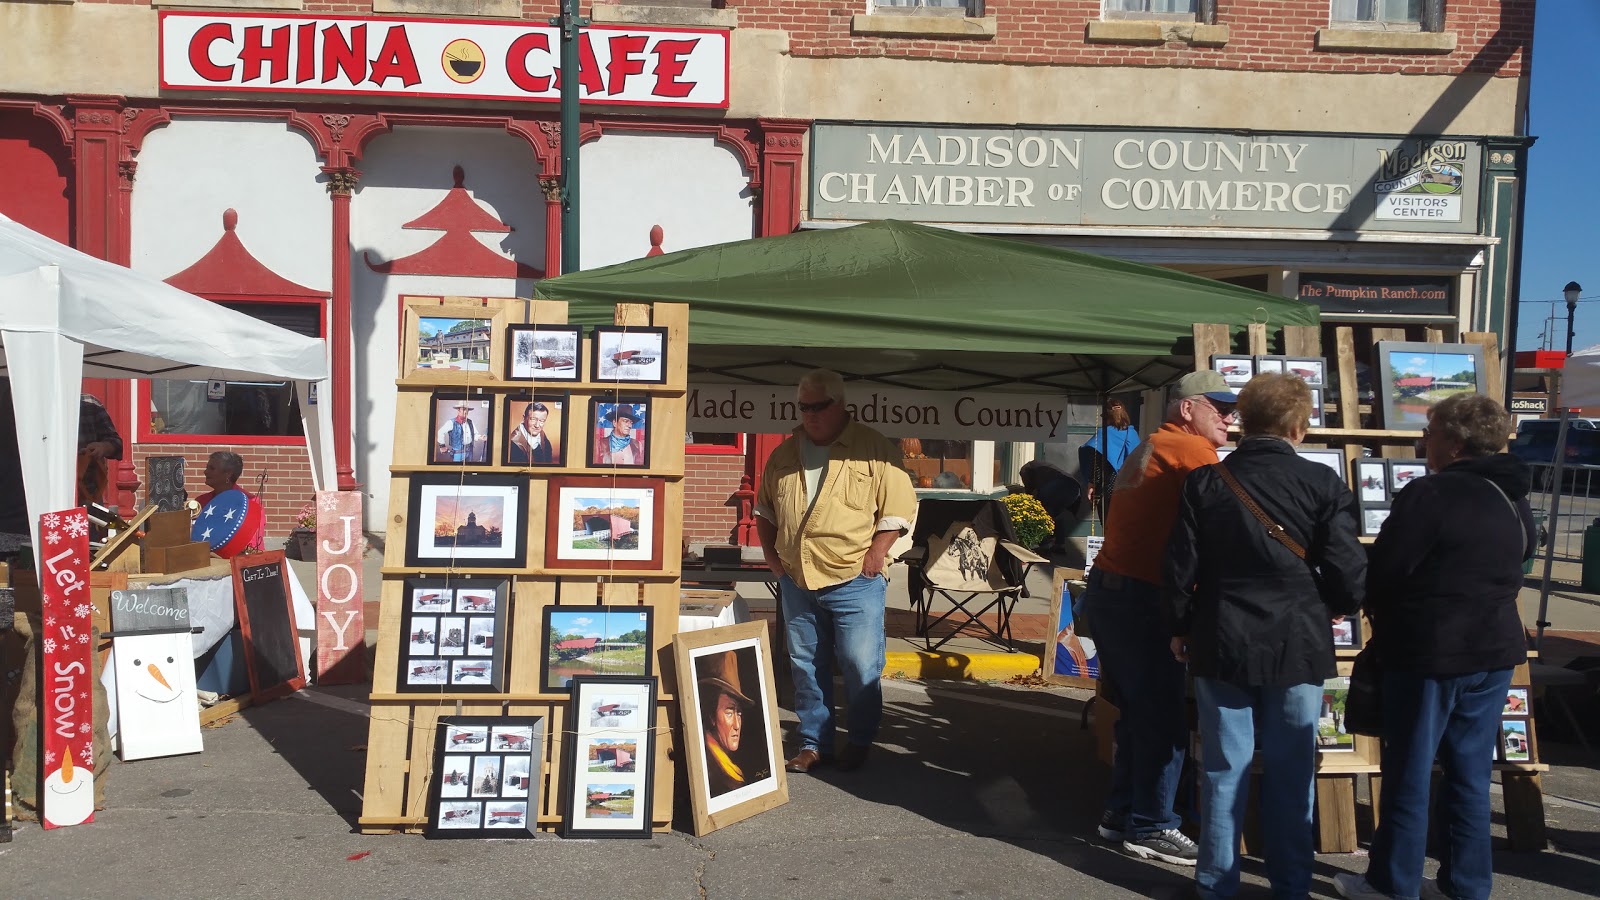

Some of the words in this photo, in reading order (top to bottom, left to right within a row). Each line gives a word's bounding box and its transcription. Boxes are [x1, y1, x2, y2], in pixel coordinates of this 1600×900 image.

[187, 22, 422, 87] CHINA
[504, 32, 701, 99] CAFE
[868, 133, 1082, 169] MADISON
[1112, 138, 1309, 174] COUNTY
[1377, 140, 1466, 182] Madison
[818, 172, 1035, 209] CHAMBER
[1047, 183, 1082, 201] OF
[1101, 179, 1352, 214] COMMERCE
[1376, 171, 1420, 191] COUNTY
[1389, 197, 1448, 207] VISITORS
[1393, 208, 1444, 217] CENTER
[1301, 285, 1322, 297] The
[1326, 286, 1378, 300] Pumpkin
[1381, 287, 1446, 299] Ranch.com
[770, 393, 797, 421] in
[847, 394, 941, 425] adison
[954, 397, 1064, 439] County
[45, 548, 85, 596] Let
[321, 516, 359, 651] JOY
[112, 590, 187, 620] Welcome
[59, 624, 76, 641] It
[54, 660, 86, 739] Snow
